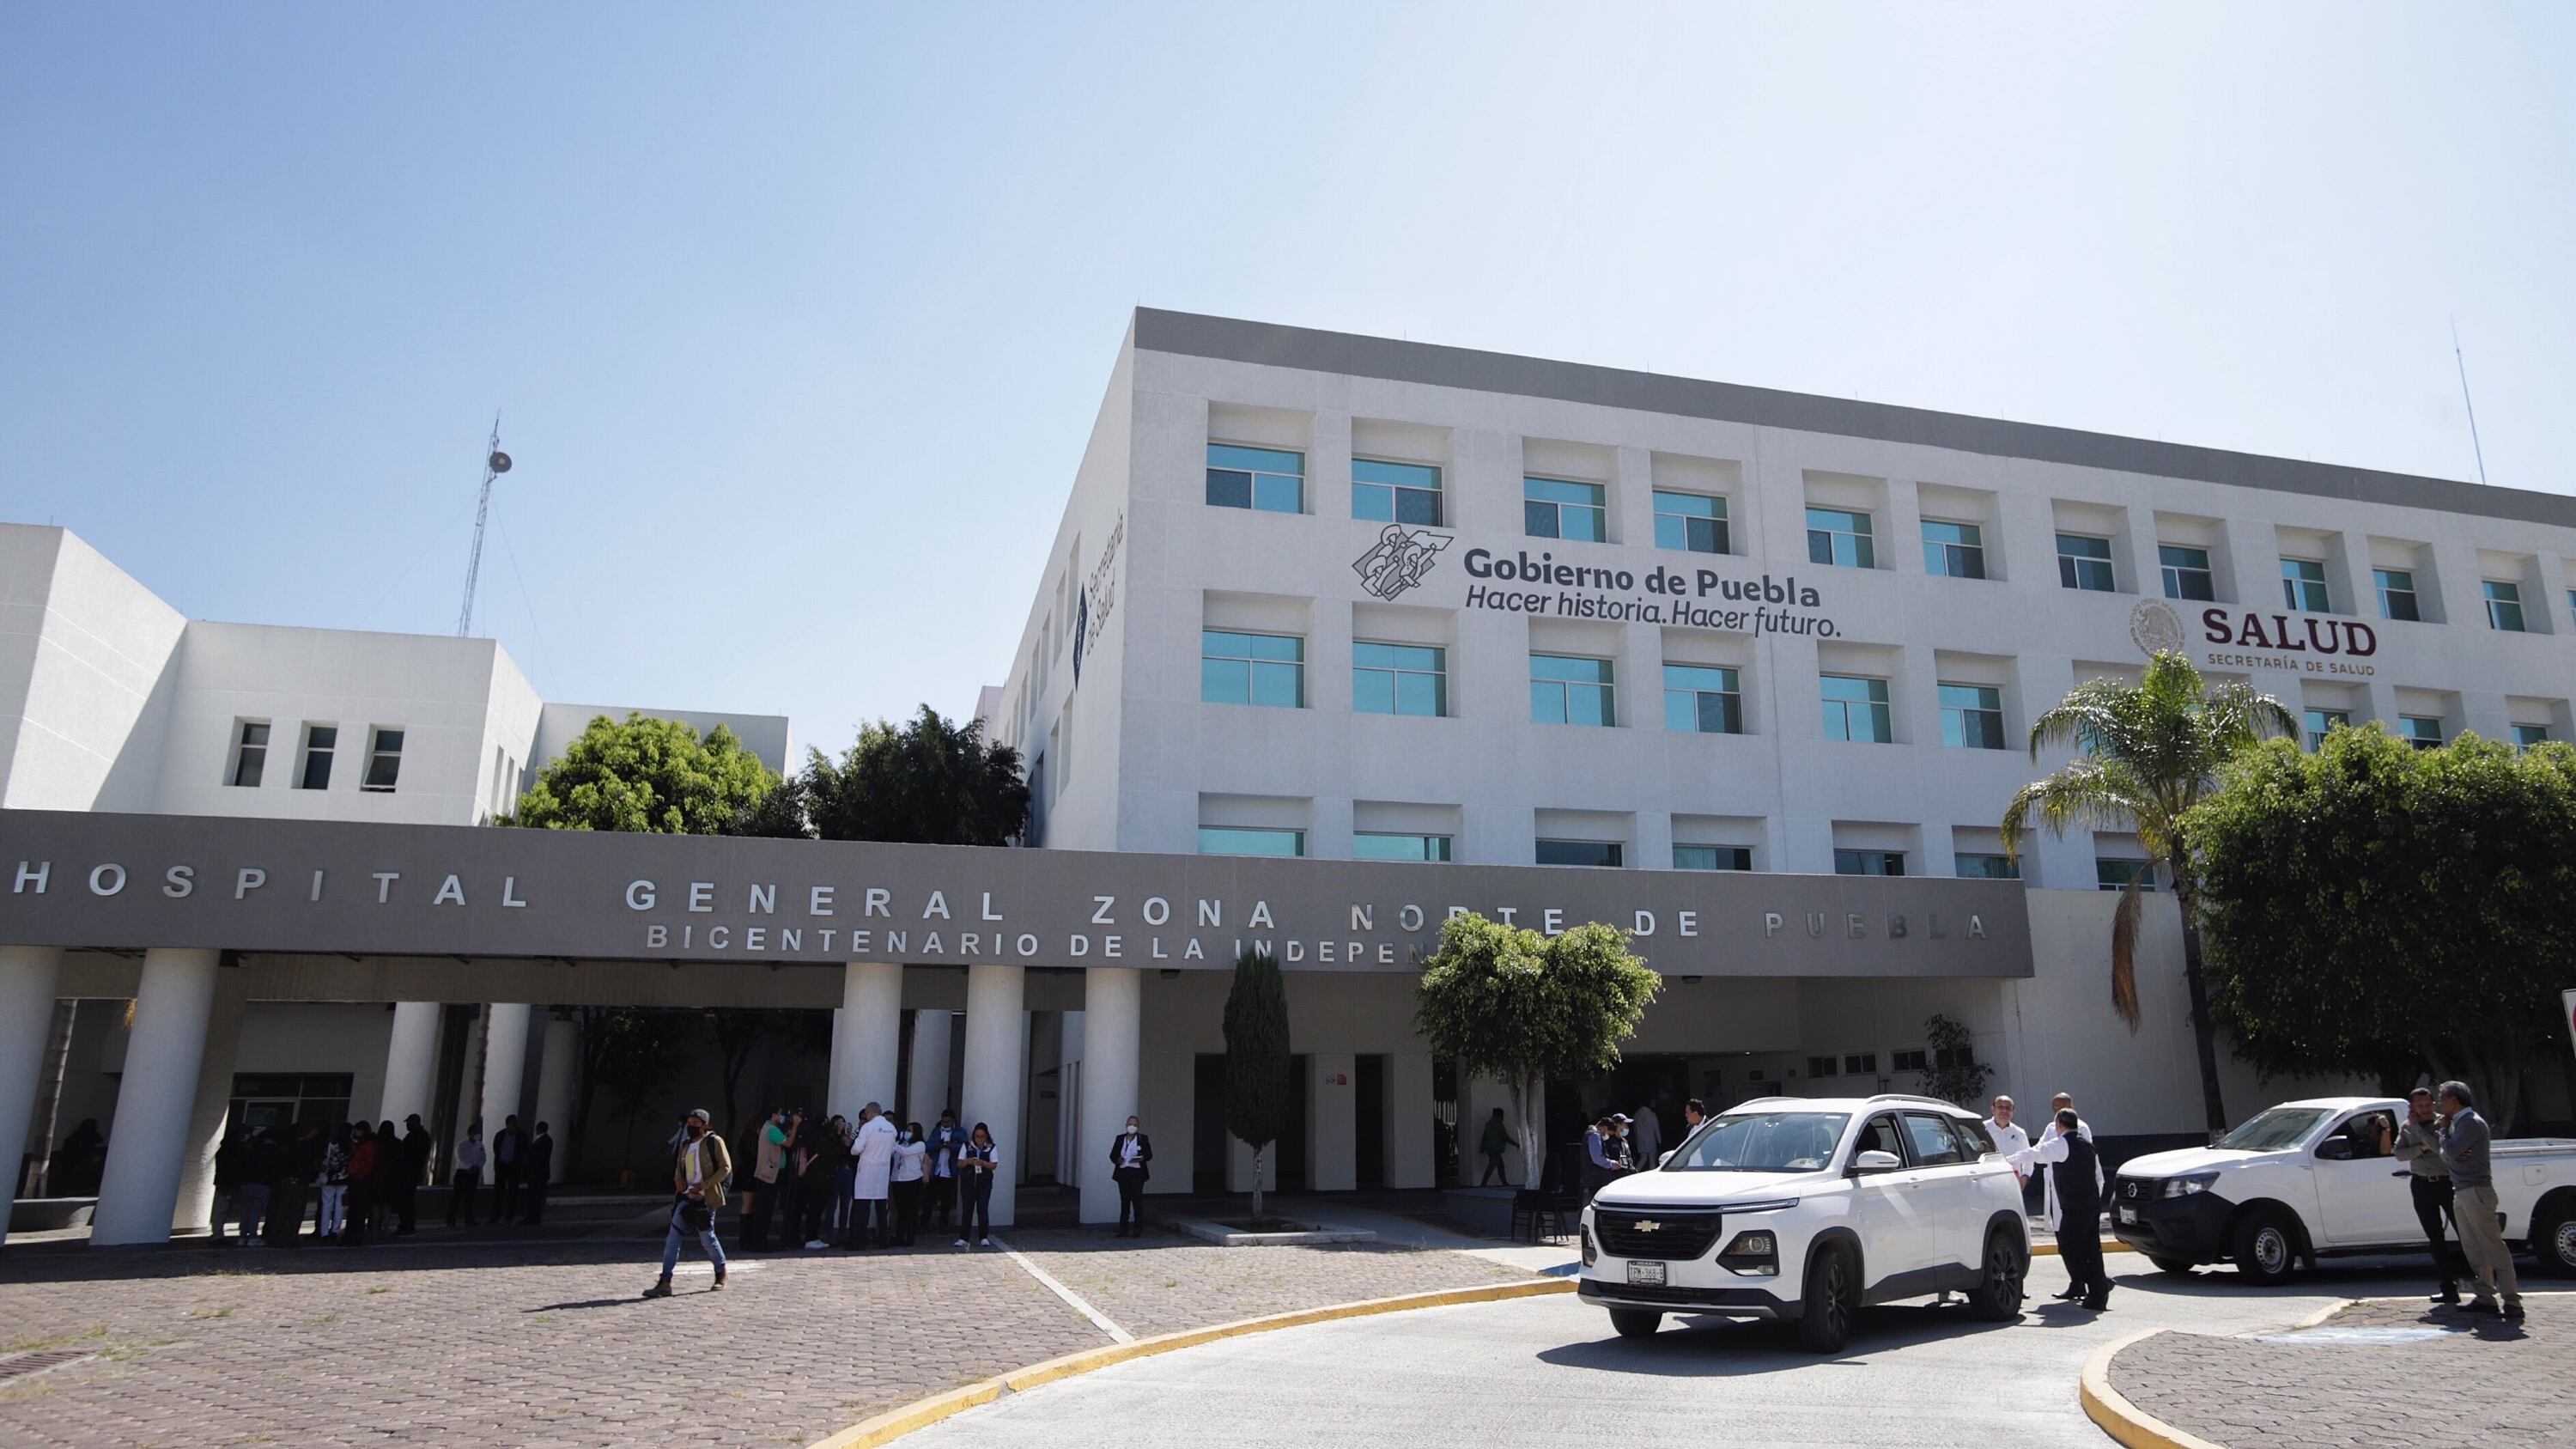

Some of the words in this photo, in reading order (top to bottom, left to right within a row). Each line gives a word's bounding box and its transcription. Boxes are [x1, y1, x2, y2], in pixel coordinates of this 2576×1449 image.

[1464, 548, 1634, 590] Gobierno
[1644, 565, 1687, 595] de
[1697, 569, 1821, 607] Puebla
[1465, 585, 1552, 615] Hacer
[1556, 593, 1667, 624] historia.
[1672, 605, 1749, 630] Hacer
[1753, 607, 1841, 637] futuro.
[2202, 608, 2377, 656] SALUD
[2208, 653, 2299, 671] SECRETARÍA
[2306, 661, 2324, 673] DE
[2330, 663, 2375, 676] SALUD
[13, 860, 527, 907] HOSPITAL
[625, 880, 1003, 921] GENERAL
[1091, 895, 1274, 928] ZONA
[1634, 910, 1698, 936] DE
[1765, 912, 1987, 941] PUEBLA
[647, 924, 1039, 957] BICENTENARIO
[1070, 934, 1121, 958] DE
[1153, 937, 1204, 959] LA
[1235, 939, 1443, 963] INDEPEN
